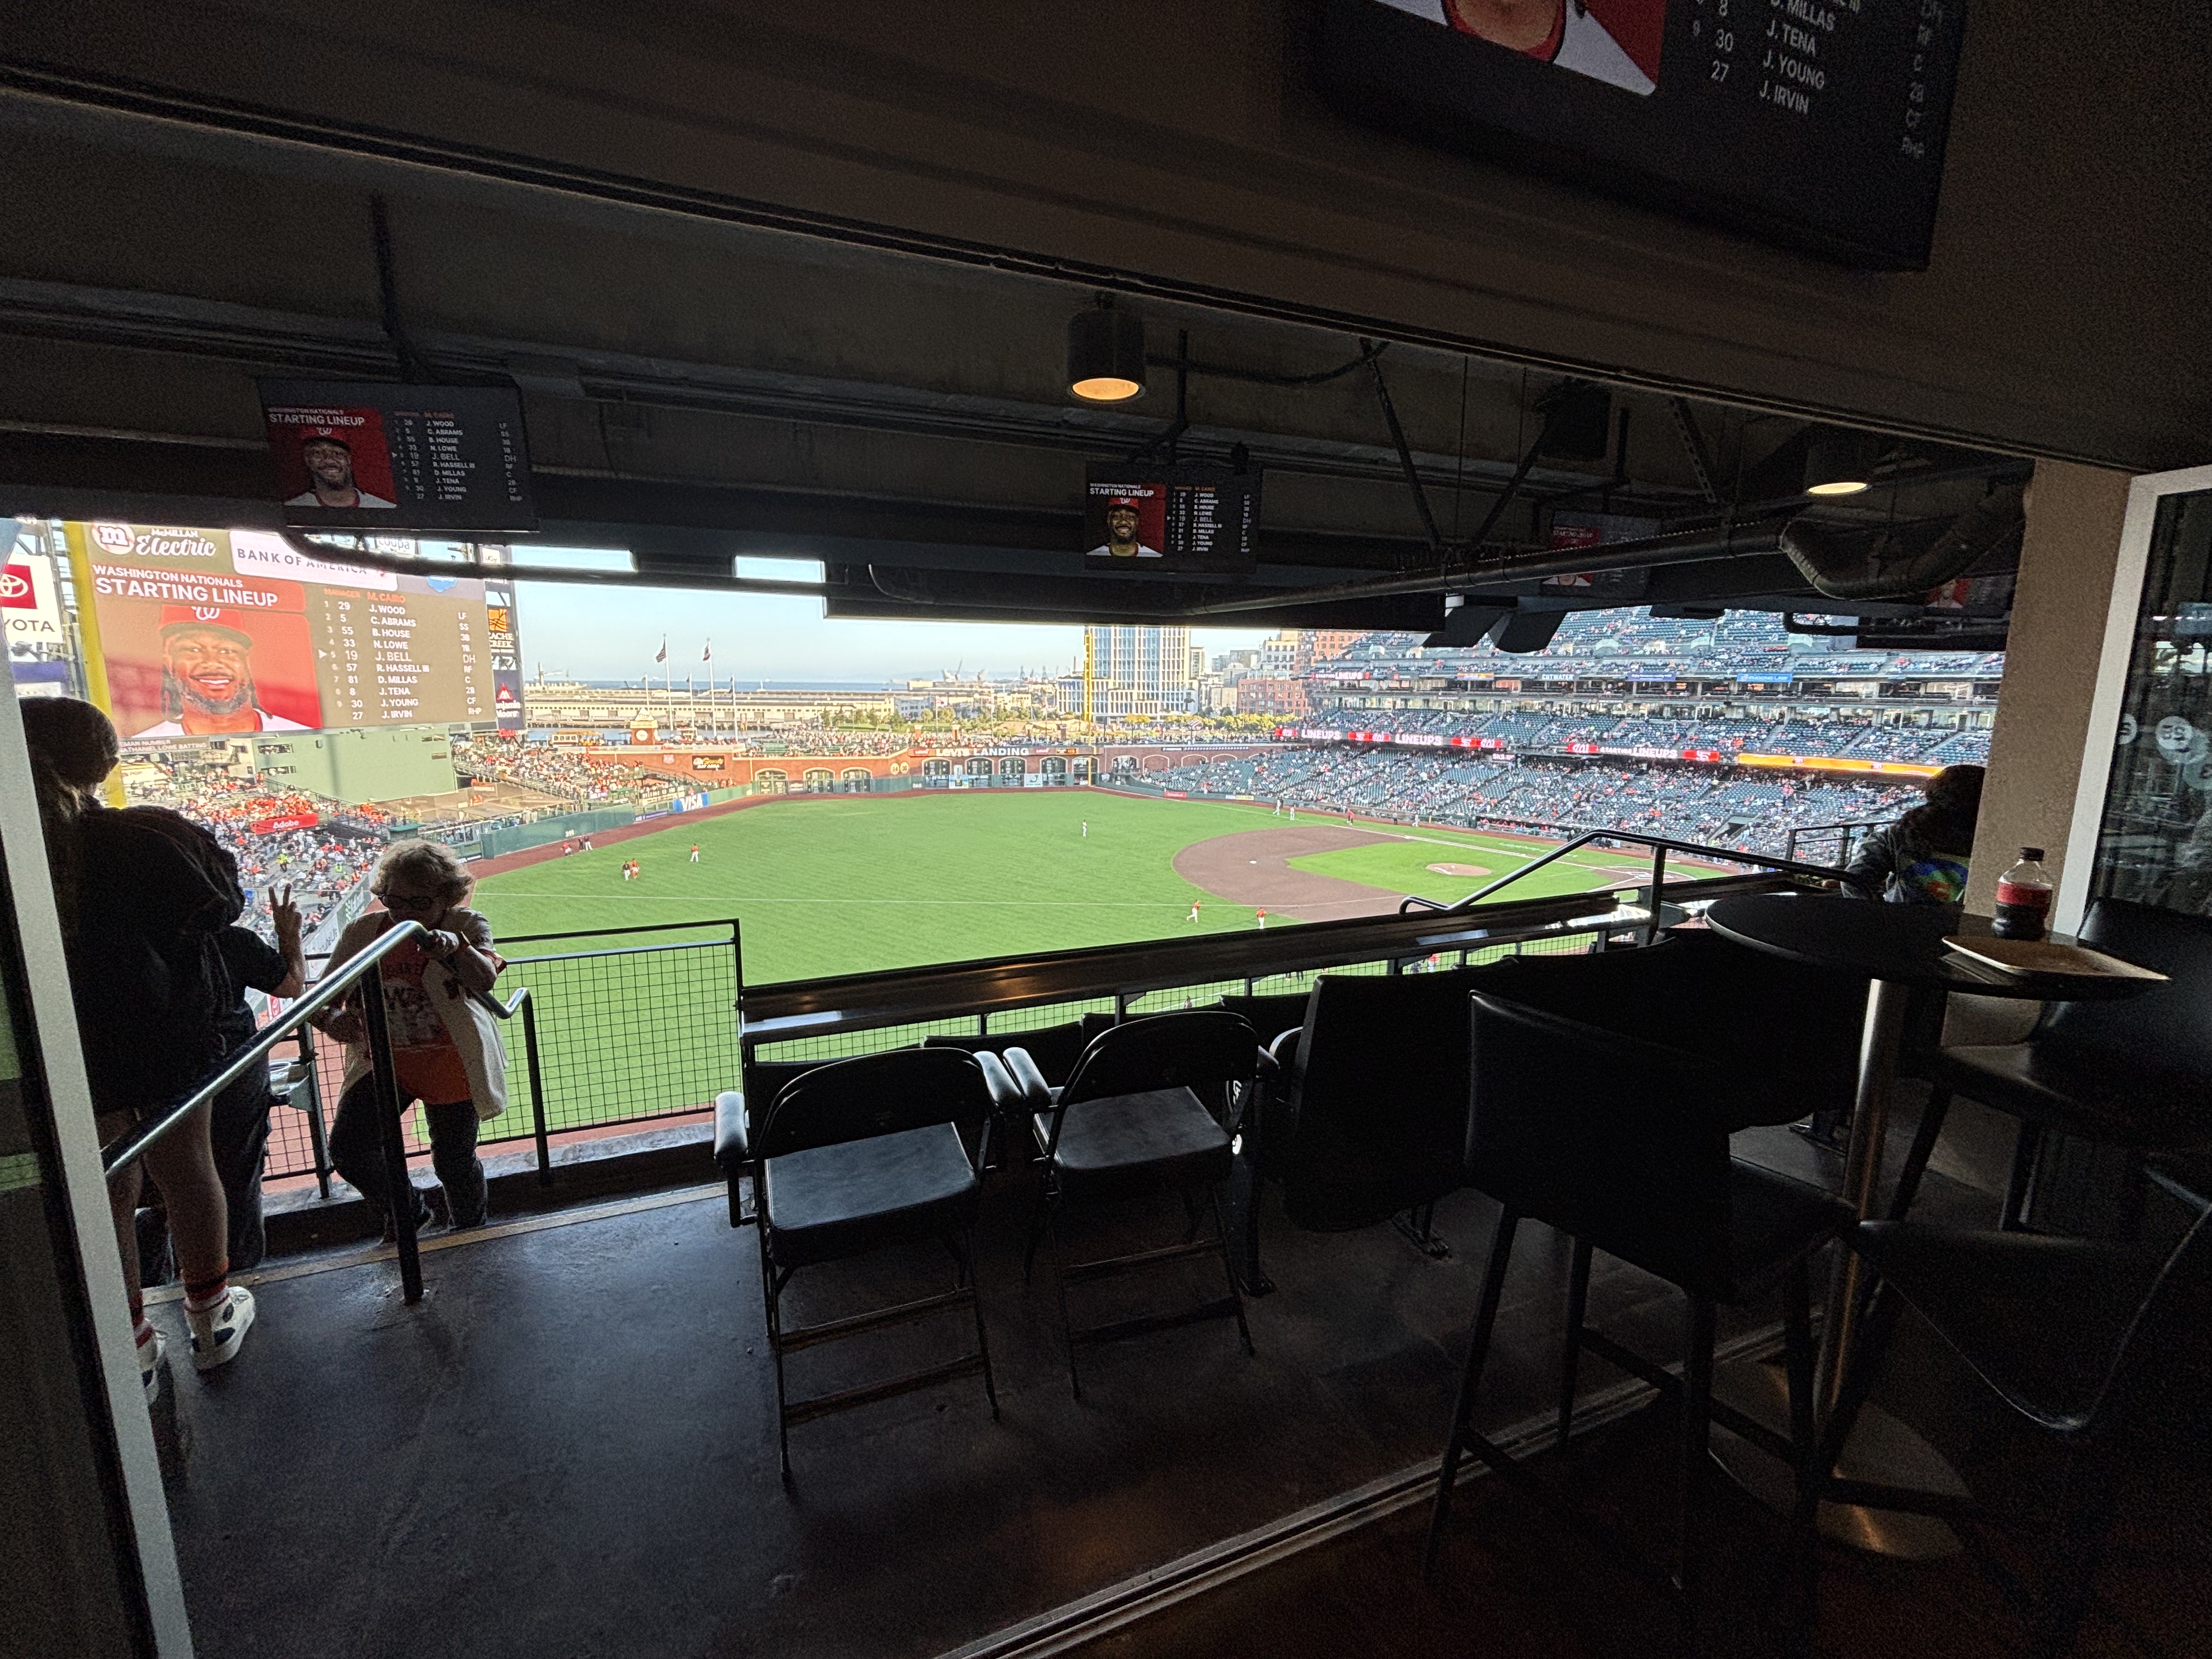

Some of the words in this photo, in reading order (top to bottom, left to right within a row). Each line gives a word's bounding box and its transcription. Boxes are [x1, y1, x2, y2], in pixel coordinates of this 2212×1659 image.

[1767, 20, 1779, 40] J.
[1782, 24, 1816, 57] TENA
[1716, 29, 1734, 52] 30
[1763, 49, 1774, 70] J.
[1779, 53, 1825, 90] YOUNG
[1711, 59, 1729, 82] 27
[1759, 80, 1771, 100] J.
[1773, 84, 1810, 115] IRVIN
[269, 413, 325, 425] STARTING
[327, 416, 365, 426] LINEUP
[1090, 488, 1127, 496] STARTING
[1128, 489, 1154, 497] LINEUP
[151, 528, 199, 538] McMILLAN
[135, 534, 217, 556] Electric
[379, 538, 410, 550] coupa
[236, 548, 281, 563] BANK
[284, 555, 302, 566] OF
[92, 564, 179, 583] WASHINGTON
[180, 574, 243, 588] NATIONALS
[96, 577, 208, 602] STARTING
[212, 587, 278, 607] LINEUP
[338, 601, 351, 611] 29
[369, 604, 378, 613] J.
[378, 605, 406, 615] WOOD
[458, 612, 466, 620] LF
[340, 614, 347, 623] 5
[370, 616, 381, 625] C.
[382, 617, 416, 627] ABRAMS
[459, 623, 469, 631] SS
[341, 627, 354, 635] 55
[372, 628, 381, 636] B.
[382, 629, 411, 638] HOUSE
[343, 639, 356, 647] 33
[374, 640, 382, 648] N.
[383, 641, 409, 650] LOWE
[345, 650, 358, 661] 19
[375, 651, 385, 662] J.
[387, 651, 412, 662] BELL
[462, 653, 476, 664] DH
[346, 663, 358, 672] 57
[376, 664, 385, 672] R.
[386, 664, 421, 673] HASSELL
[347, 675, 358, 684] 81
[377, 676, 387, 684] D.
[388, 676, 417, 684] MILLAS
[1335, 671, 1363, 680] LINEUPS
[349, 687, 356, 696] 8
[379, 687, 388, 696] J.
[465, 686, 475, 695] 2B
[351, 699, 363, 708] 30
[380, 698, 389, 707] J.
[389, 698, 419, 707] YOUNG
[466, 697, 476, 705] CF
[352, 712, 363, 720] 27
[382, 710, 390, 719] J.
[390, 710, 413, 718] IRVIN
[1301, 729, 1341, 740] LINEUPS
[1395, 733, 1443, 747] LINEUPS
[973, 747, 1029, 757] LANDING
[1633, 747, 1678, 759] LINEUPS
[680, 793, 703, 812] VISA
[273, 819, 300, 829] Adobe
